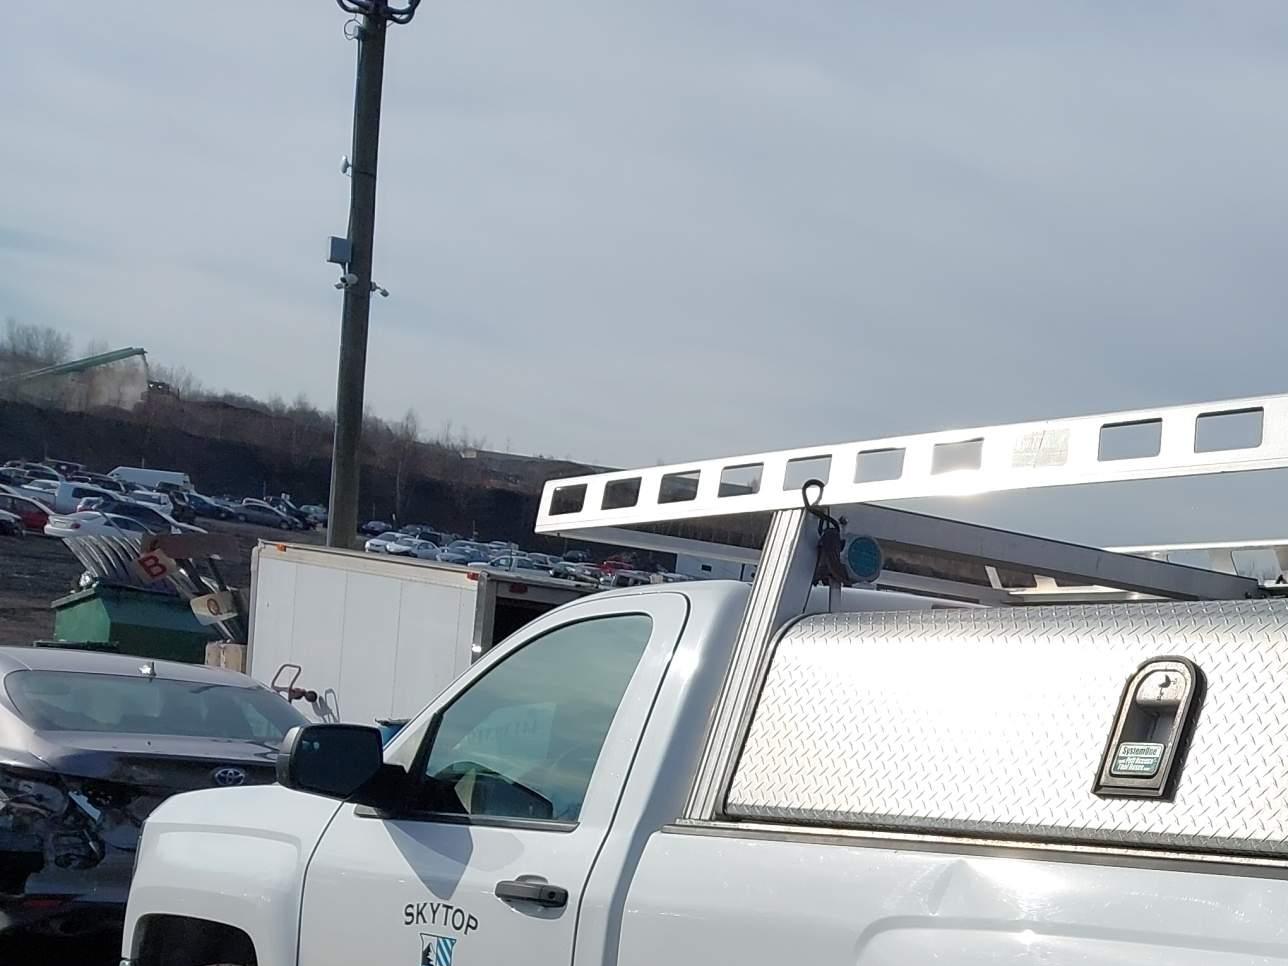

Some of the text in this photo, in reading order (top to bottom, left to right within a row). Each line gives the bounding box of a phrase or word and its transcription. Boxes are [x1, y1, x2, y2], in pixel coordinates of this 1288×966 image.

[138, 555, 168, 580] B
[206, 597, 223, 617] Q
[404, 902, 479, 936] SKYTOP
